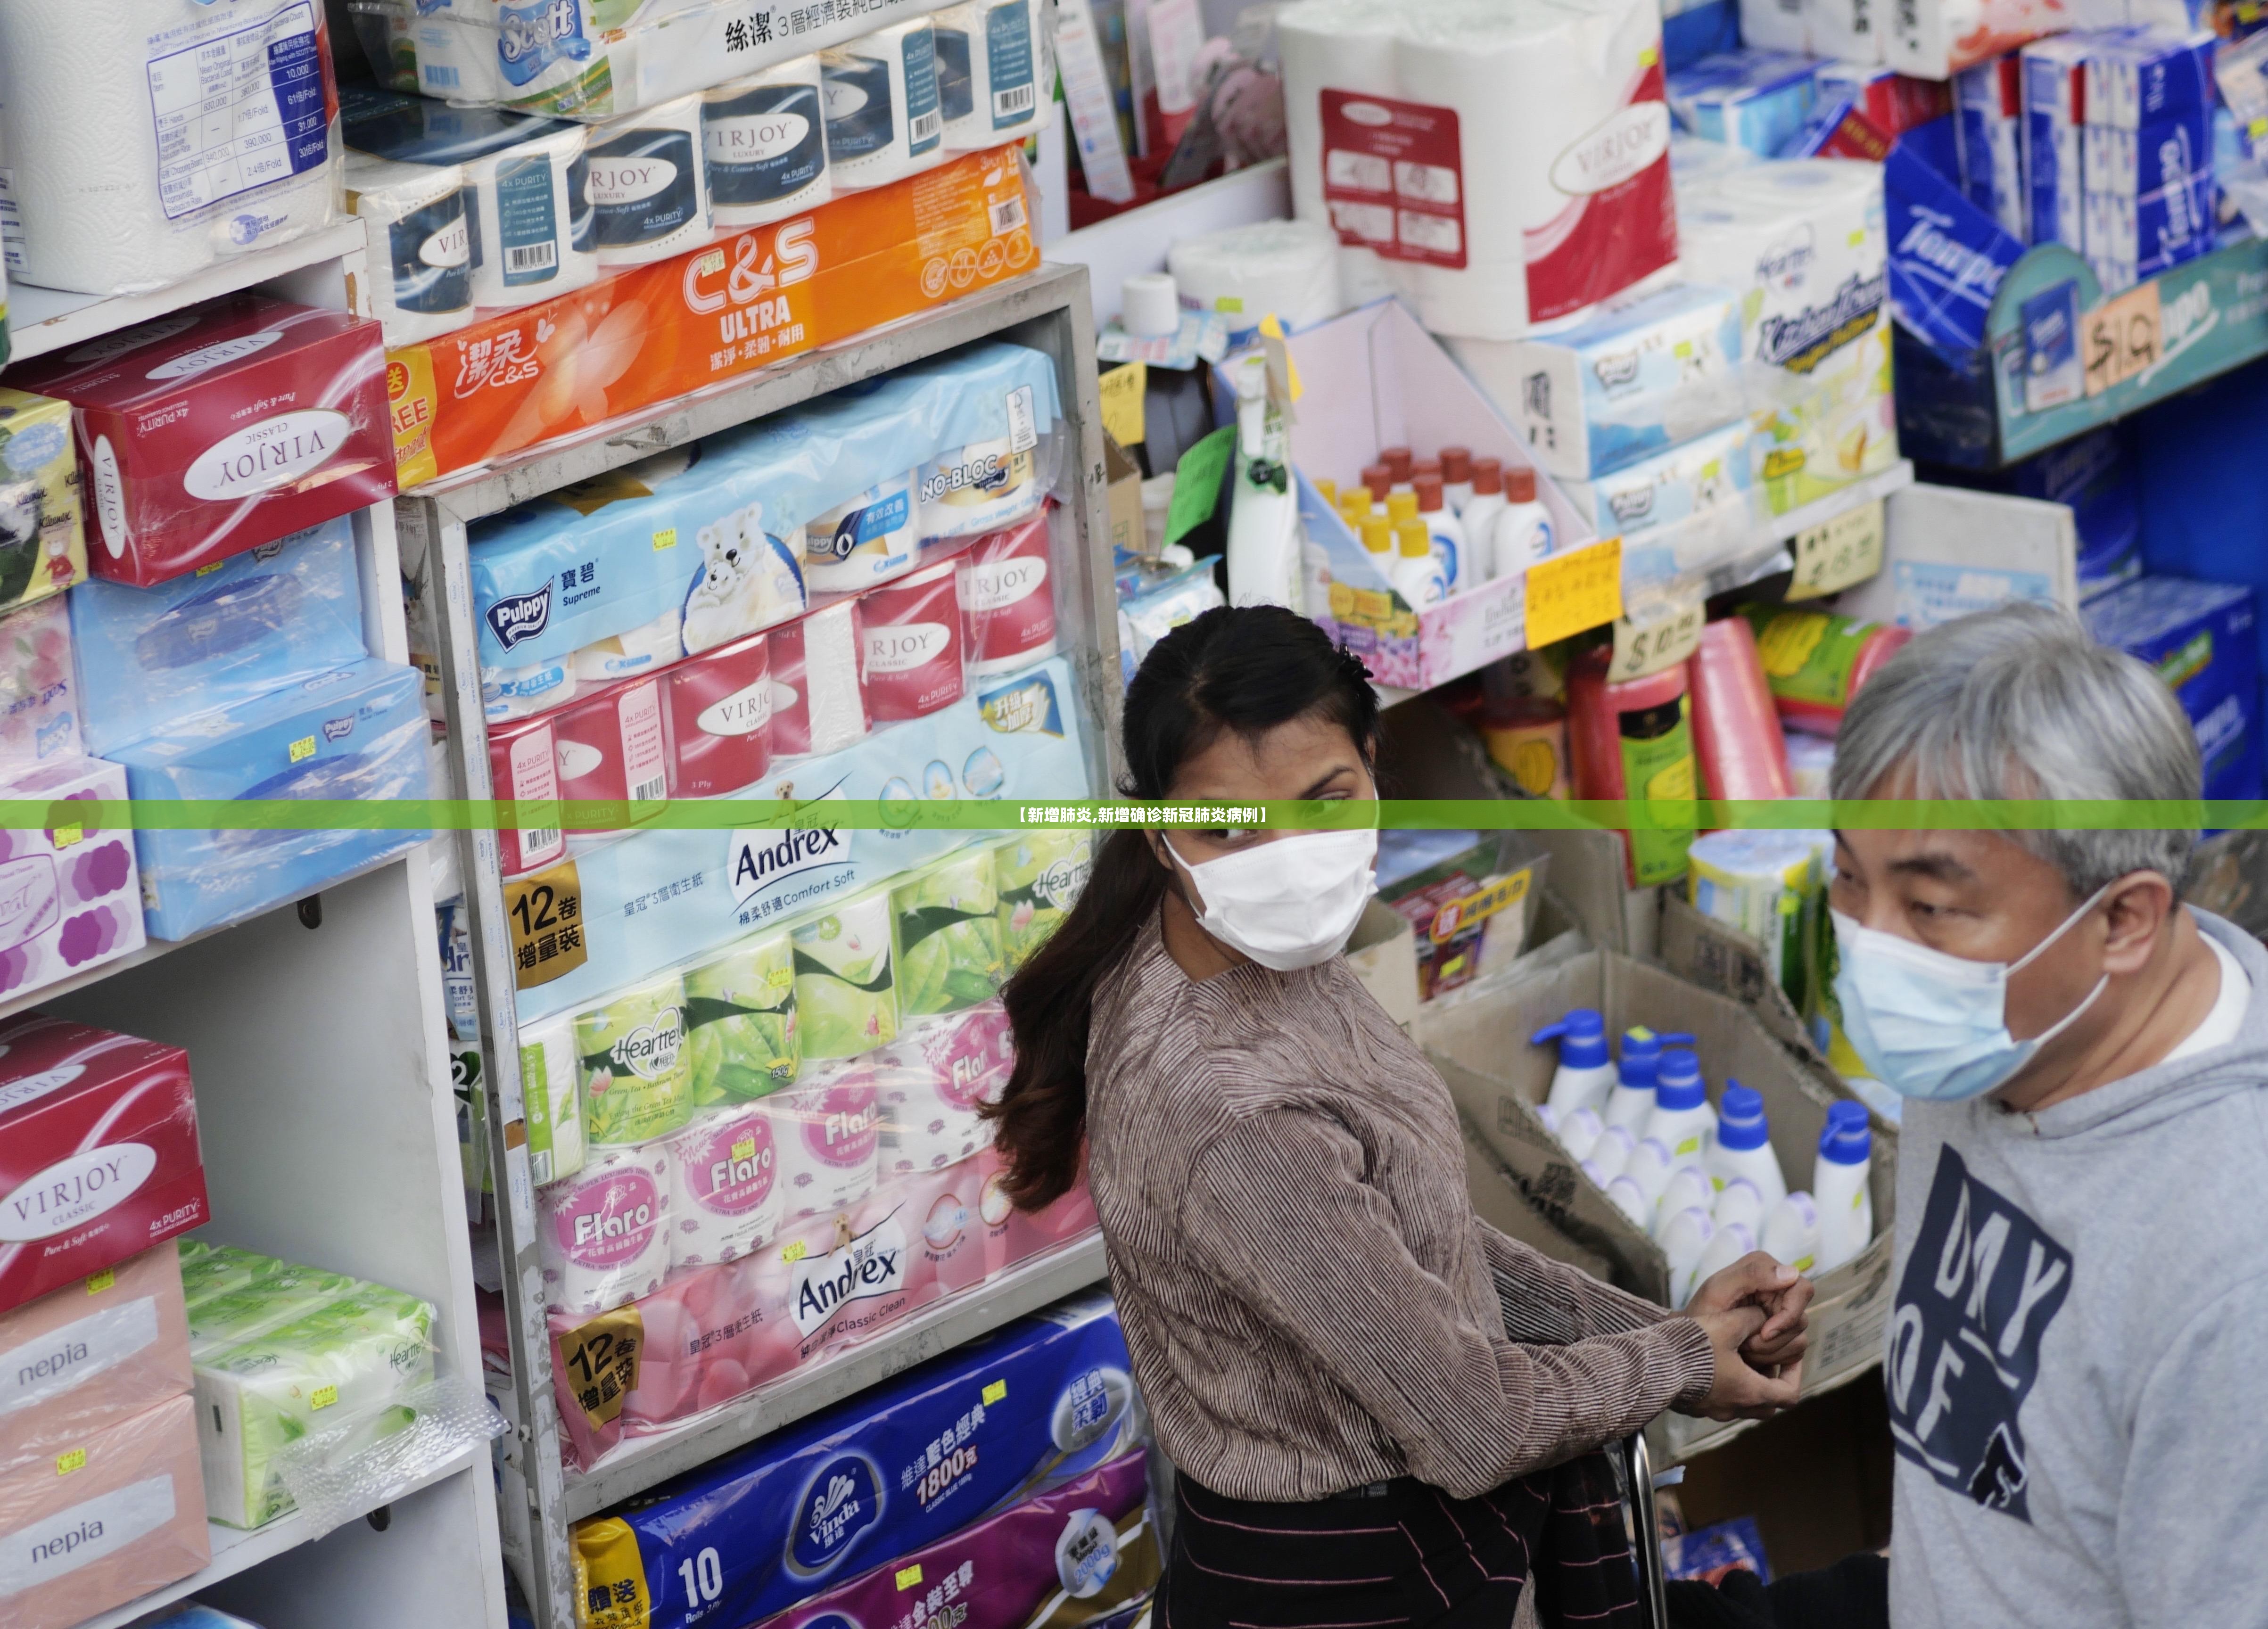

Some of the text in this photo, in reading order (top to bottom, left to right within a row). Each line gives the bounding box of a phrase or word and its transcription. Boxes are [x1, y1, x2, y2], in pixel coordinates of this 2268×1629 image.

[504, 1, 575, 60] Scott
[287, 64, 309, 79] 10,000
[204, 96, 227, 112] 630,000
[206, 147, 230, 163] 940,000
[502, 180, 513, 188] 4x
[515, 173, 546, 186] PURITY
[792, 165, 813, 177] PURITY
[655, 211, 681, 222] PURITY
[1897, 203, 2006, 296] Tempo
[683, 217, 818, 316] C&S
[720, 295, 792, 345] ULTRA
[176, 338, 266, 371] VIRJOY
[490, 361, 539, 388] C&S
[253, 392, 296, 411] Pure & Soft
[140, 408, 189, 432] 4x PURITY
[246, 422, 288, 444] CLASSIC
[220, 430, 325, 486] VIRJOY
[921, 455, 998, 503] NO-BLOC
[16, 488, 47, 507] Kleenex
[101, 457, 119, 536] VIRJOY
[41, 511, 71, 528] Kleenex
[561, 562, 595, 592] 寶碧
[498, 592, 549, 628] Pulppy
[562, 586, 601, 607] Supreme
[918, 683, 957, 703] 4x PURITY
[325, 716, 354, 733] Pulppy
[635, 707, 656, 721] PURITY
[517, 750, 548, 770] 4x PURITY
[698, 780, 712, 790] Ply
[575, 806, 615, 819] PURITY
[735, 822, 841, 886] Andrex
[783, 869, 855, 907] Comfort Soft
[738, 899, 783, 926] 棉柔舒適
[517, 925, 581, 972] 增量裝
[771, 1064, 789, 1078] 150g
[609, 1087, 627, 1096] Green
[647, 1075, 671, 1090] Bathroom
[632, 1104, 642, 1113] the
[644, 1100, 660, 1110] Green
[662, 1097, 672, 1105] Tea
[825, 1100, 876, 1146] Flaro
[578, 1179, 598, 1191] SUPER
[601, 1168, 634, 1179] LUXURIOUS
[710, 1147, 771, 1193] Flaro
[14, 1158, 122, 1221] VIRJOY
[51, 1202, 97, 1226] CLASSIC
[150, 1203, 198, 1231] 4x PURITY
[710, 1202, 758, 1216] EXTRA SOFT AND
[574, 1203, 649, 1247] Flaro
[44, 1241, 62, 1257] Pure
[71, 1232, 88, 1247] Soft
[853, 1241, 874, 1266] 皇冠
[573, 1258, 595, 1270] EXTRA
[800, 1250, 897, 1320] Andrex
[837, 1296, 906, 1333] Classic Clean
[18, 1342, 88, 1386] nepia
[578, 1357, 634, 1415] 增量裝
[901, 1403, 986, 1491] 維達藍色經典
[916, 1444, 978, 1506] 1800克
[925, 1482, 958, 1513] CLASSIC BLUE
[809, 1497, 860, 1545] Vinda
[32, 1519, 104, 1564] nepia
[1073, 1543, 1110, 1583] 2000g
[677, 1546, 723, 1608] 10
[685, 1610, 704, 1624] Rolls
